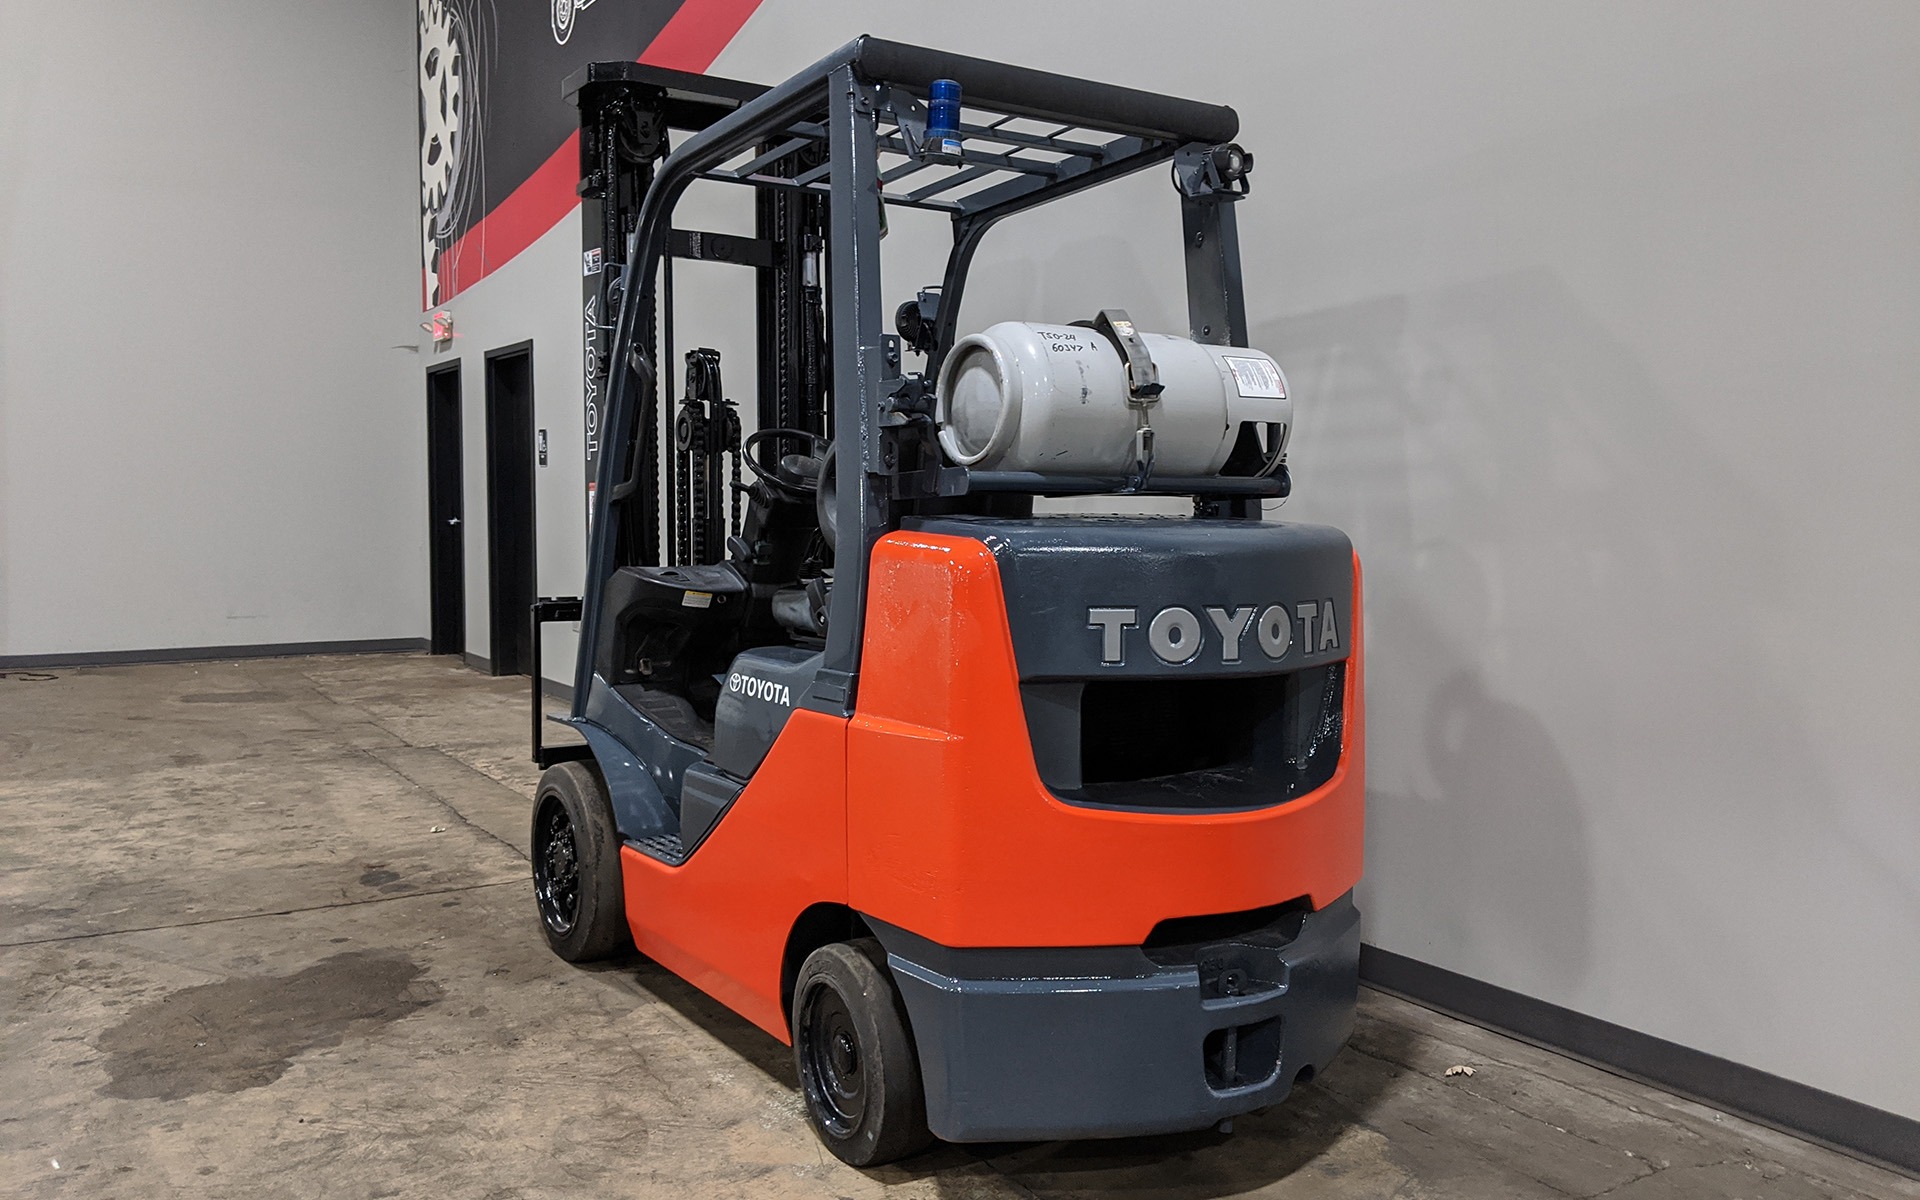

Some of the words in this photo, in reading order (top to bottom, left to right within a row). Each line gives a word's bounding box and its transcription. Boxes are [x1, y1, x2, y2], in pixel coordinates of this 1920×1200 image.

[584, 294, 599, 461] TOYOTA
[1087, 600, 1339, 665] TOYOTA
[741, 674, 790, 707] TOYOTA
